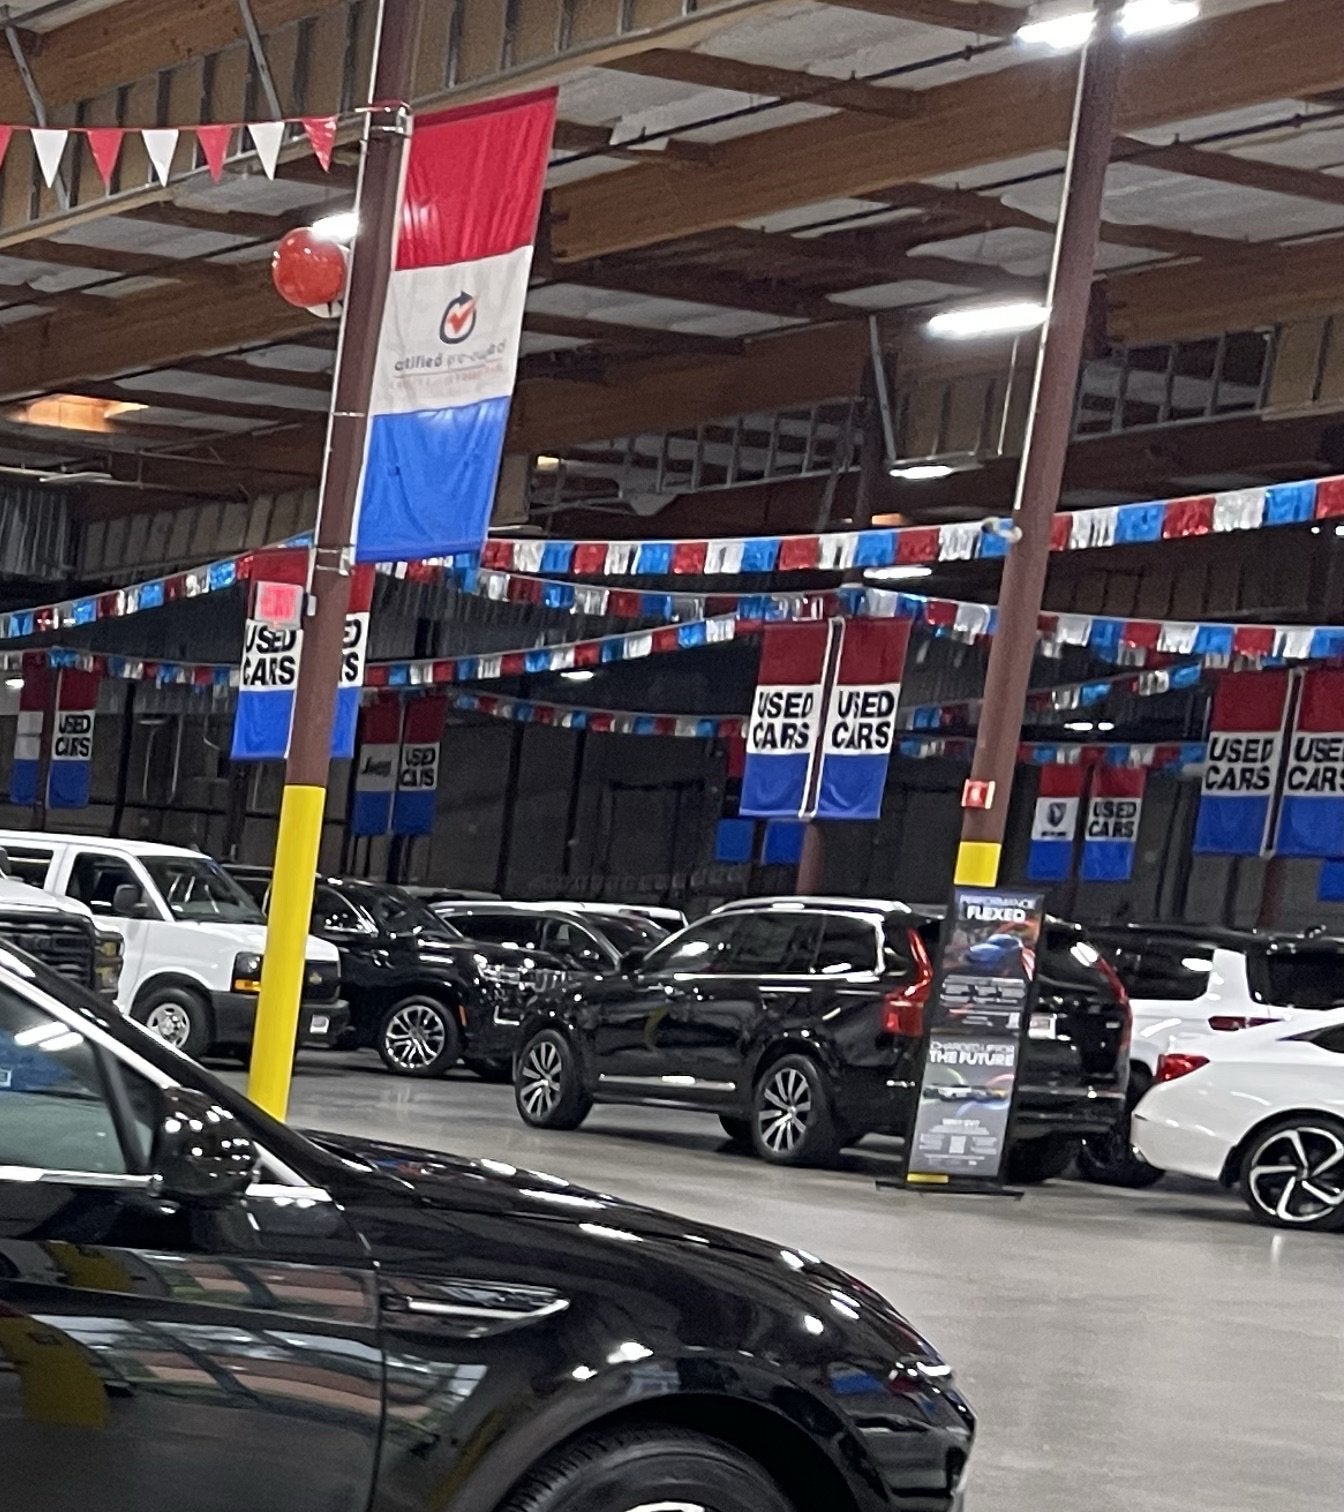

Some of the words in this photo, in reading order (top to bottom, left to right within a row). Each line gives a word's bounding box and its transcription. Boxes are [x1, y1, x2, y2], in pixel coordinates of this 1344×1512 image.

[757, 691, 815, 718] USED
[838, 690, 895, 718] USED
[752, 721, 810, 749] CARS
[831, 721, 892, 749] CARS
[1209, 737, 1275, 763] USED
[1294, 737, 1344, 763] USE
[1205, 765, 1271, 791] CARS
[967, 905, 1026, 922] FLEXED
[929, 1049, 957, 1064] THE
[958, 1050, 1015, 1067] FUTURE
